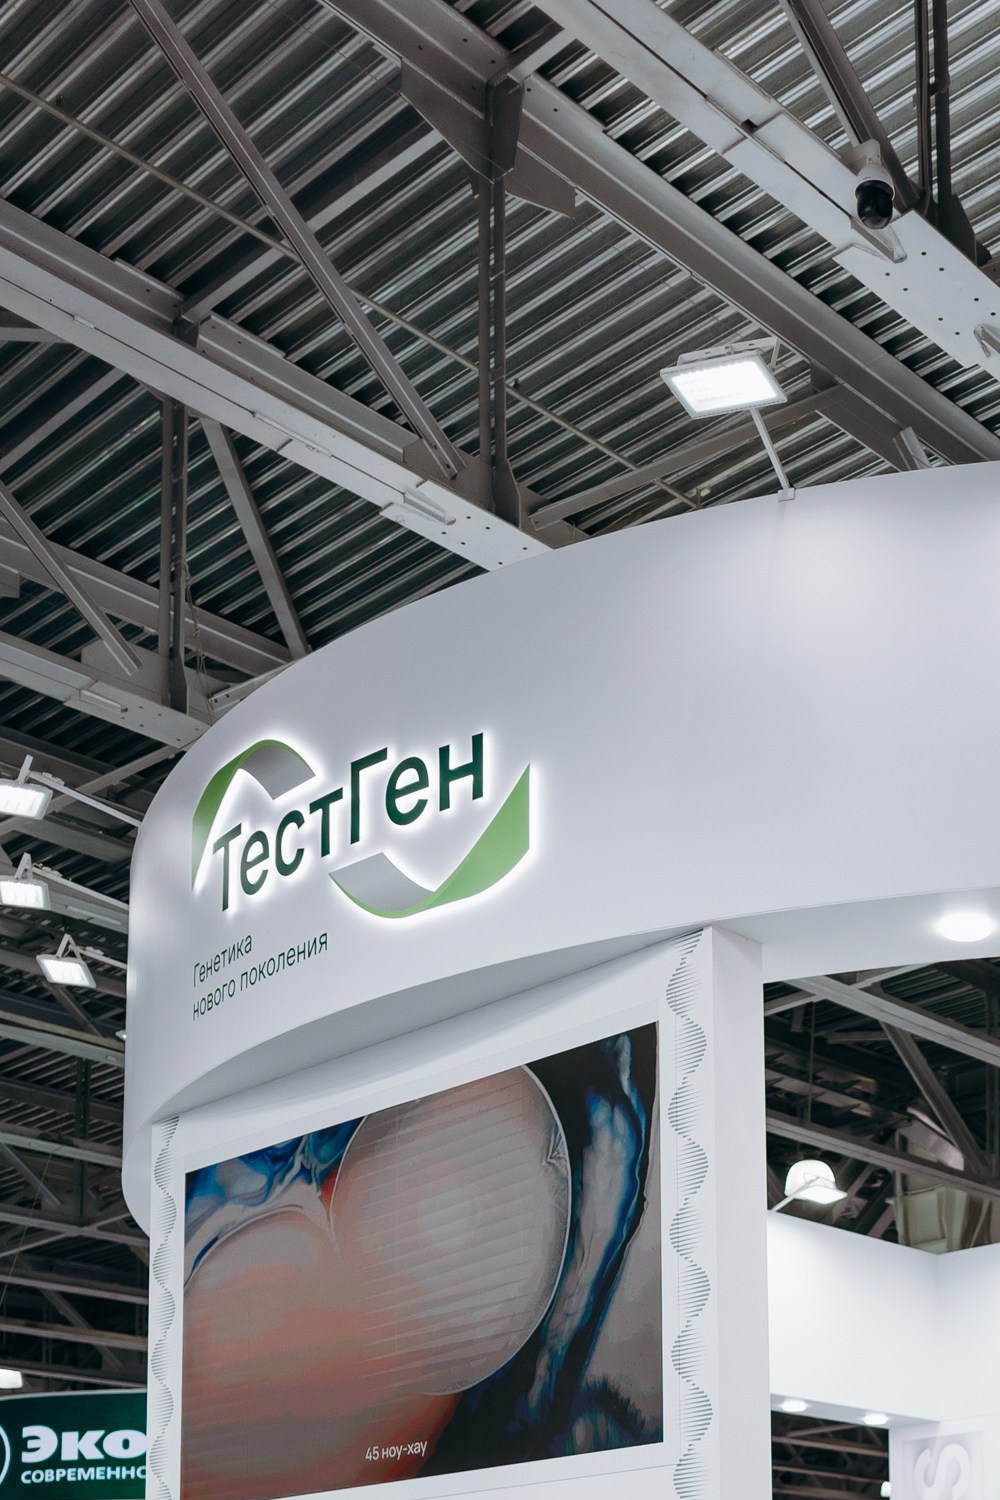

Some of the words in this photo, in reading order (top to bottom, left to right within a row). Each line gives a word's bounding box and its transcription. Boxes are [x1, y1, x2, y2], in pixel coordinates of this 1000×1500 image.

[213, 733, 484, 912] ТестГен
[192, 979, 236, 1021] нового
[240, 932, 328, 992] поколения
[193, 934, 253, 988] Генетика
[365, 1446, 380, 1461] 45
[381, 1441, 428, 1461] ноу-хау
